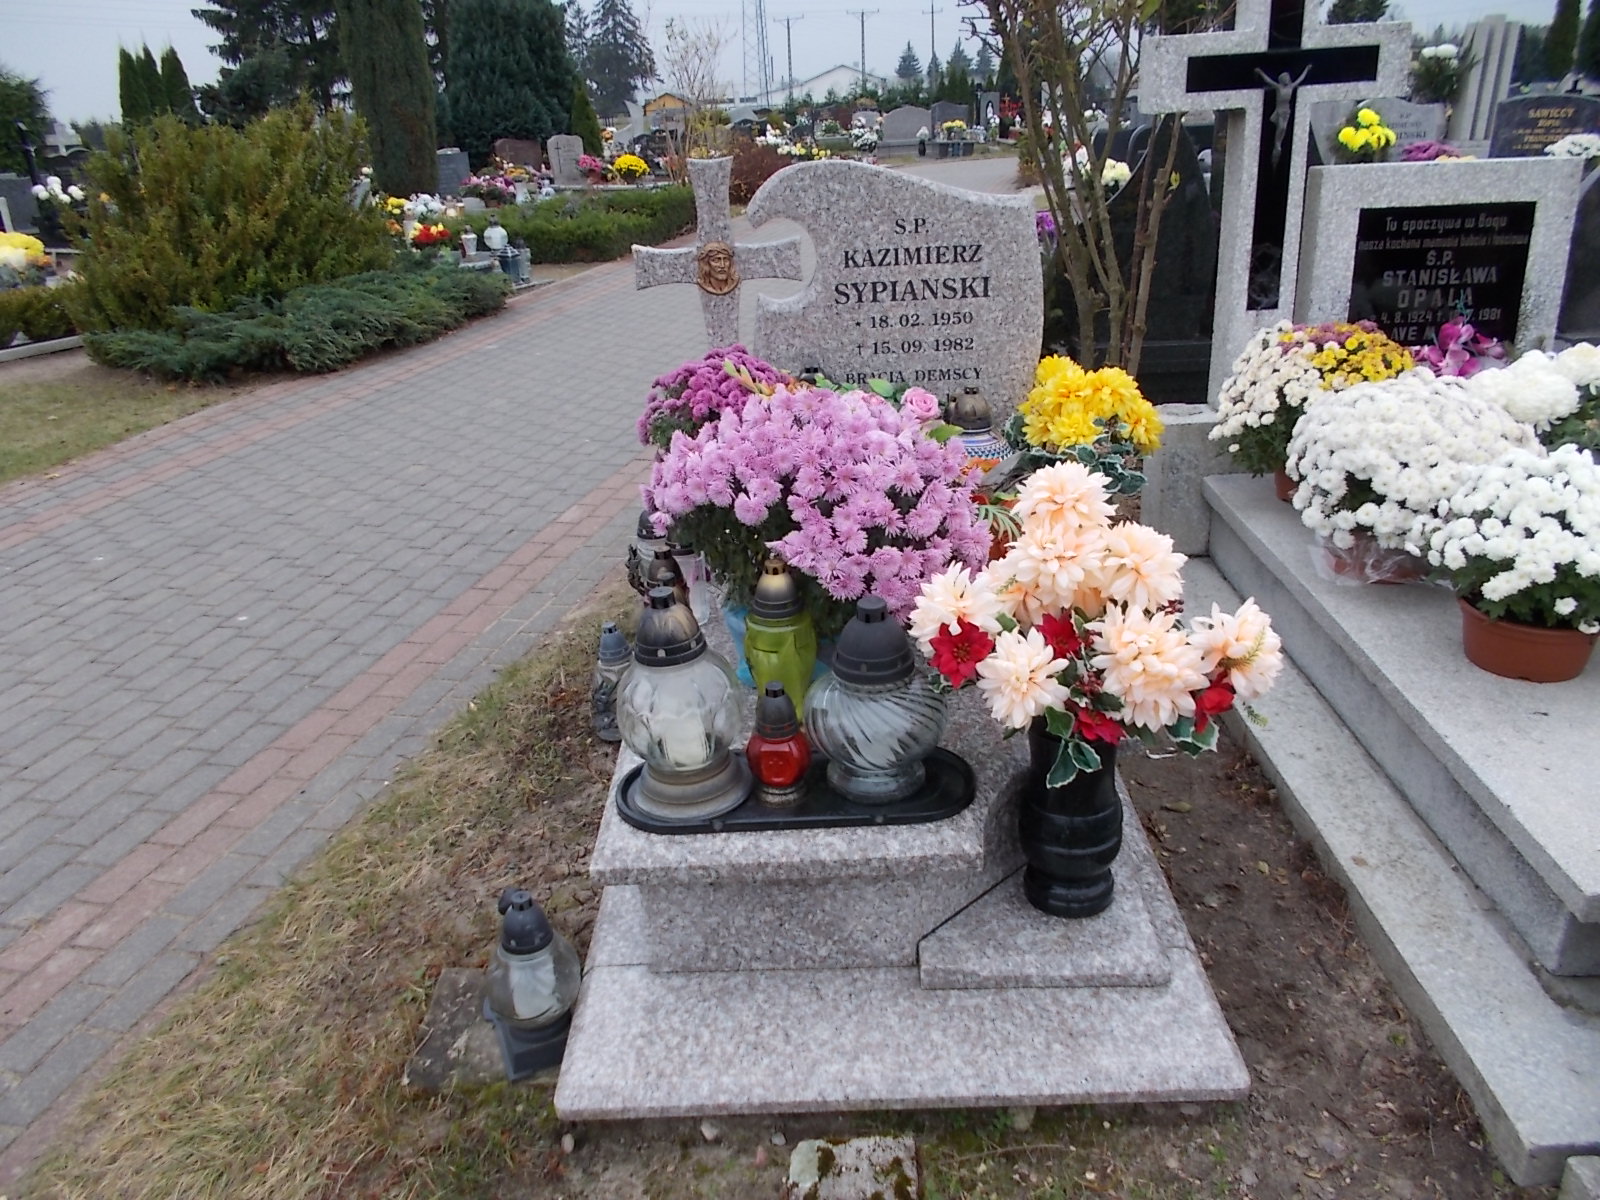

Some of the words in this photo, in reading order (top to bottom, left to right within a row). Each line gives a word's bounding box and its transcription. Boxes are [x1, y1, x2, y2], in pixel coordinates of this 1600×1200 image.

[1402, 214, 1463, 236] spoczywa
[843, 244, 983, 269] KAZIMIERZ
[1382, 265, 1497, 287] STANISŁAWA
[834, 275, 992, 305] SYPIANSKI
[1390, 326, 1418, 341] AVE
[914, 367, 983, 382] DEMSCY
